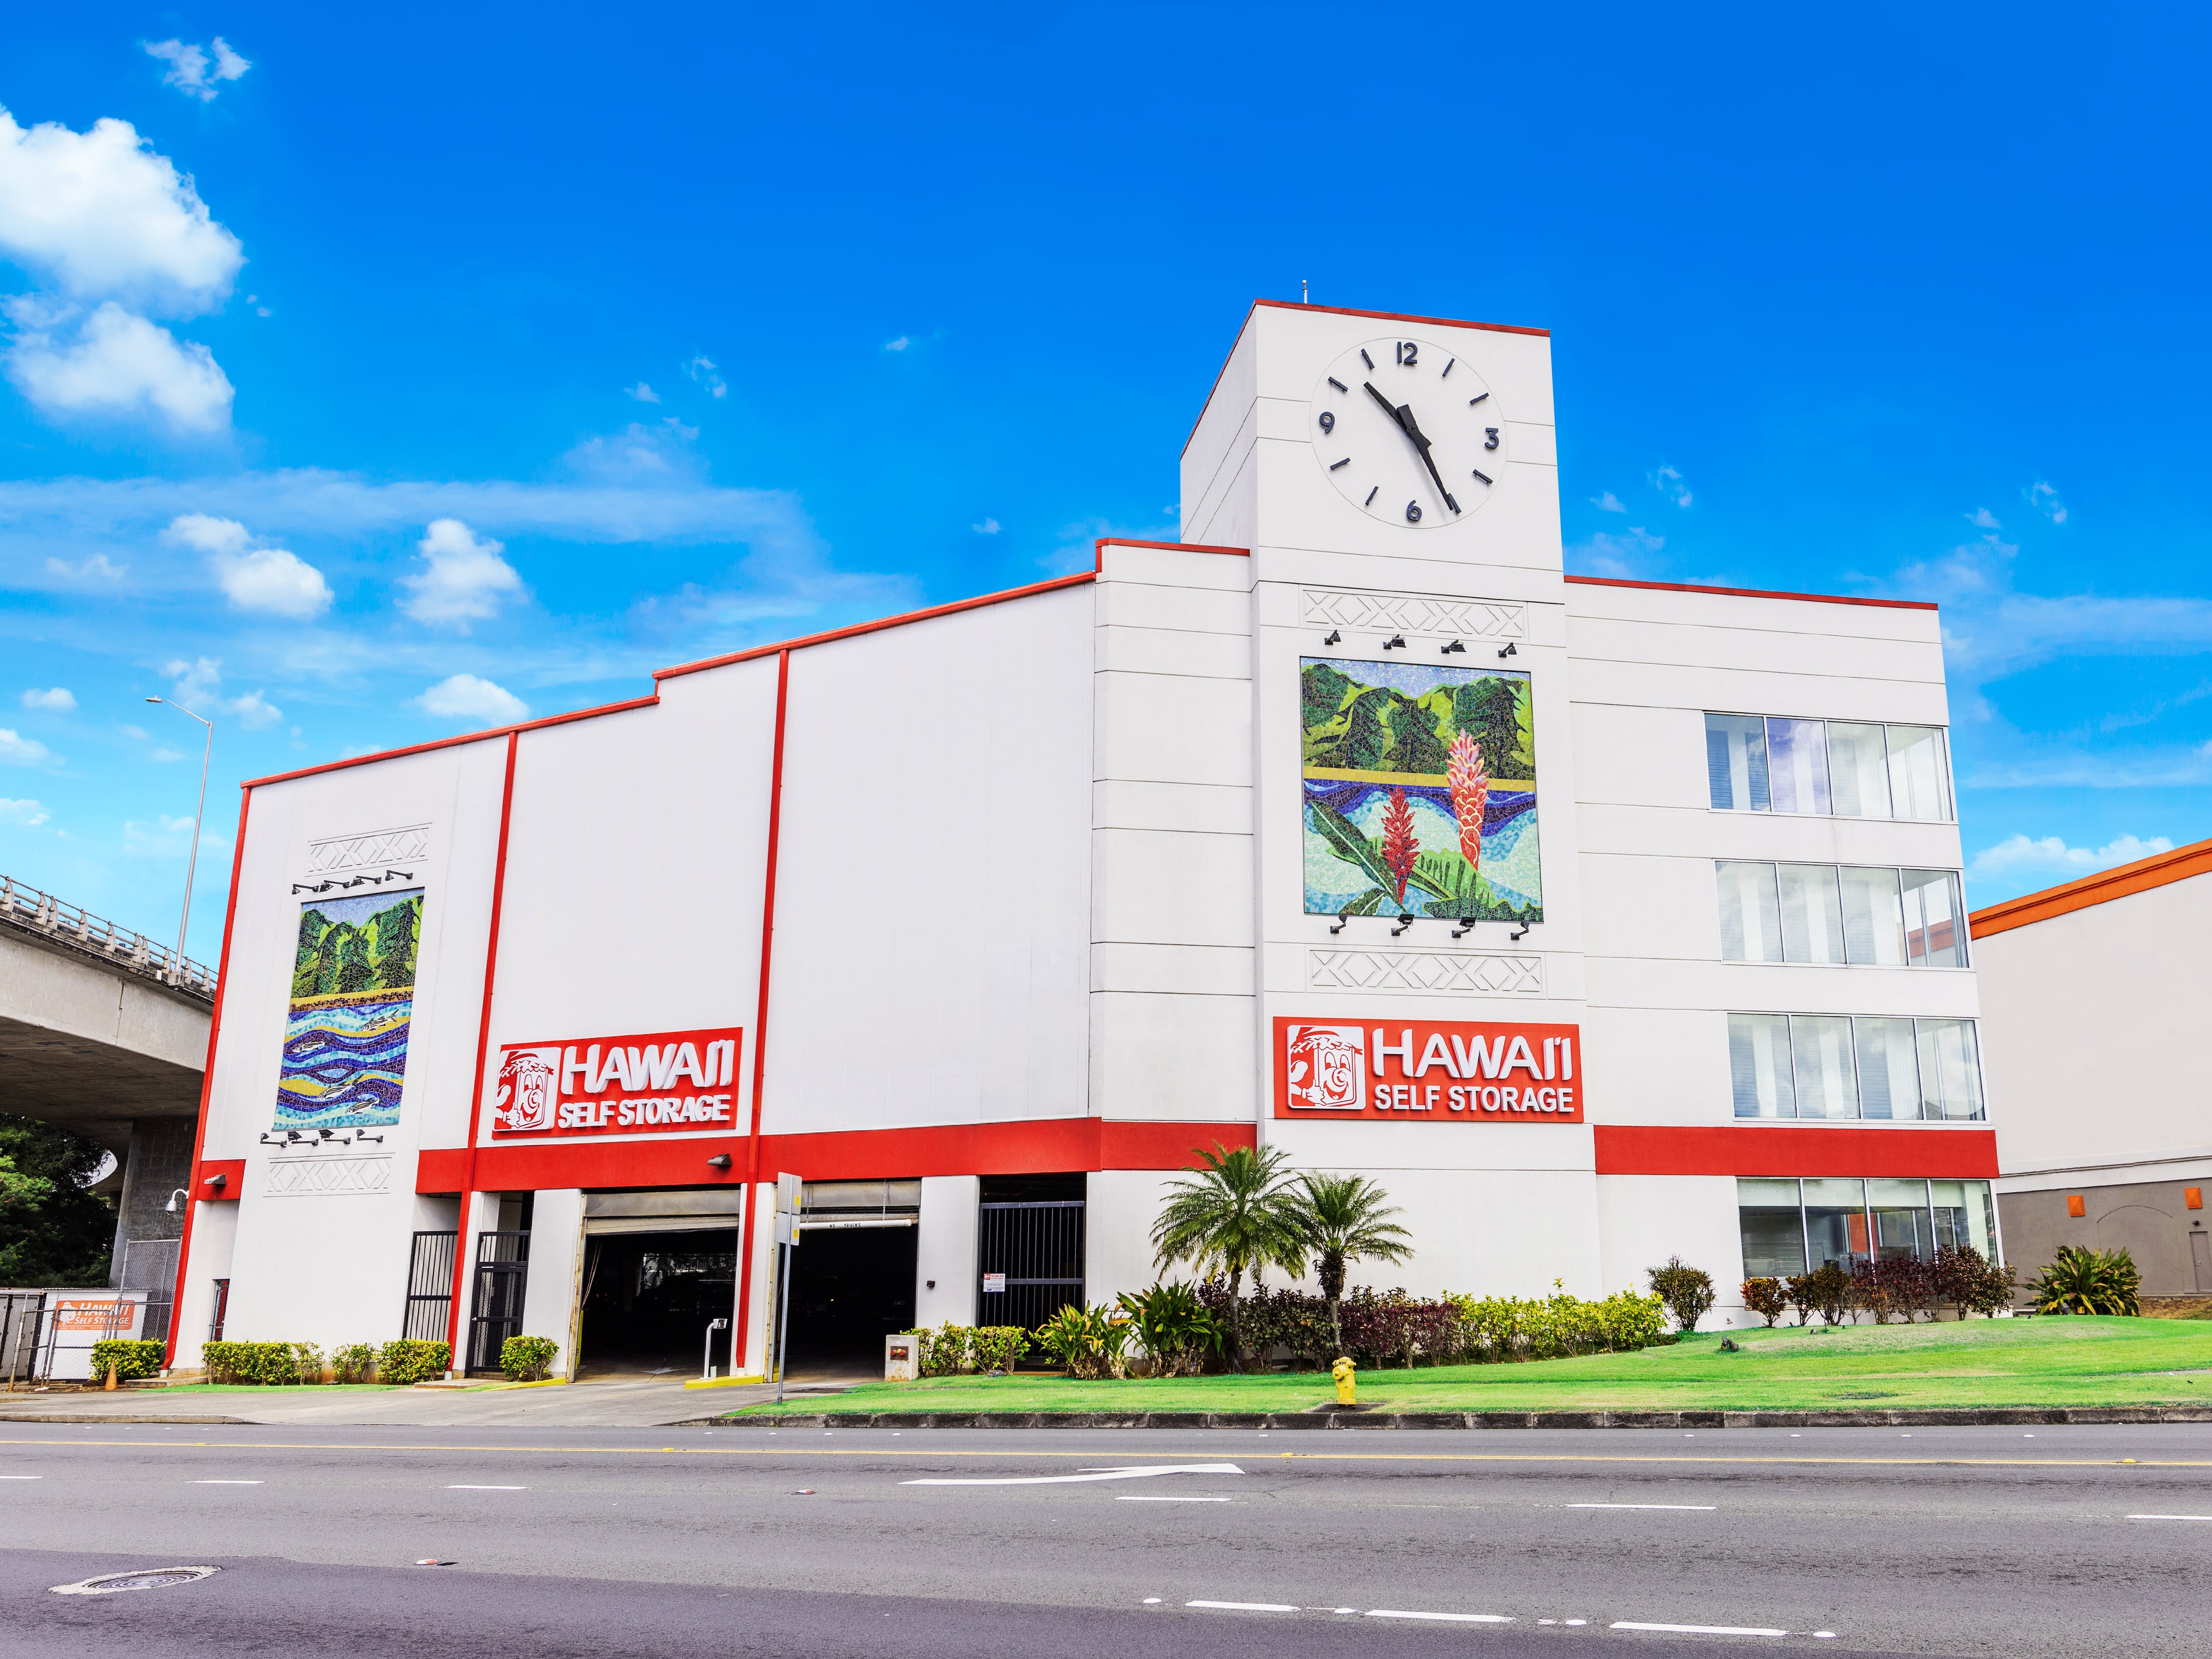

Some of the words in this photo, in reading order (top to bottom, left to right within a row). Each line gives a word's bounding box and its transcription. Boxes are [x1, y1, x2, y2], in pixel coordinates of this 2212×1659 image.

[1397, 341, 1418, 364] 12
[1319, 411, 1335, 433] 9
[1485, 427, 1499, 449] 3
[1406, 499, 1423, 522] 6
[1374, 1085, 1440, 1110] SELF
[1448, 1086, 1575, 1112] STORAGE
[558, 1101, 616, 1128] SELF
[618, 1094, 731, 1125] STORAGE
